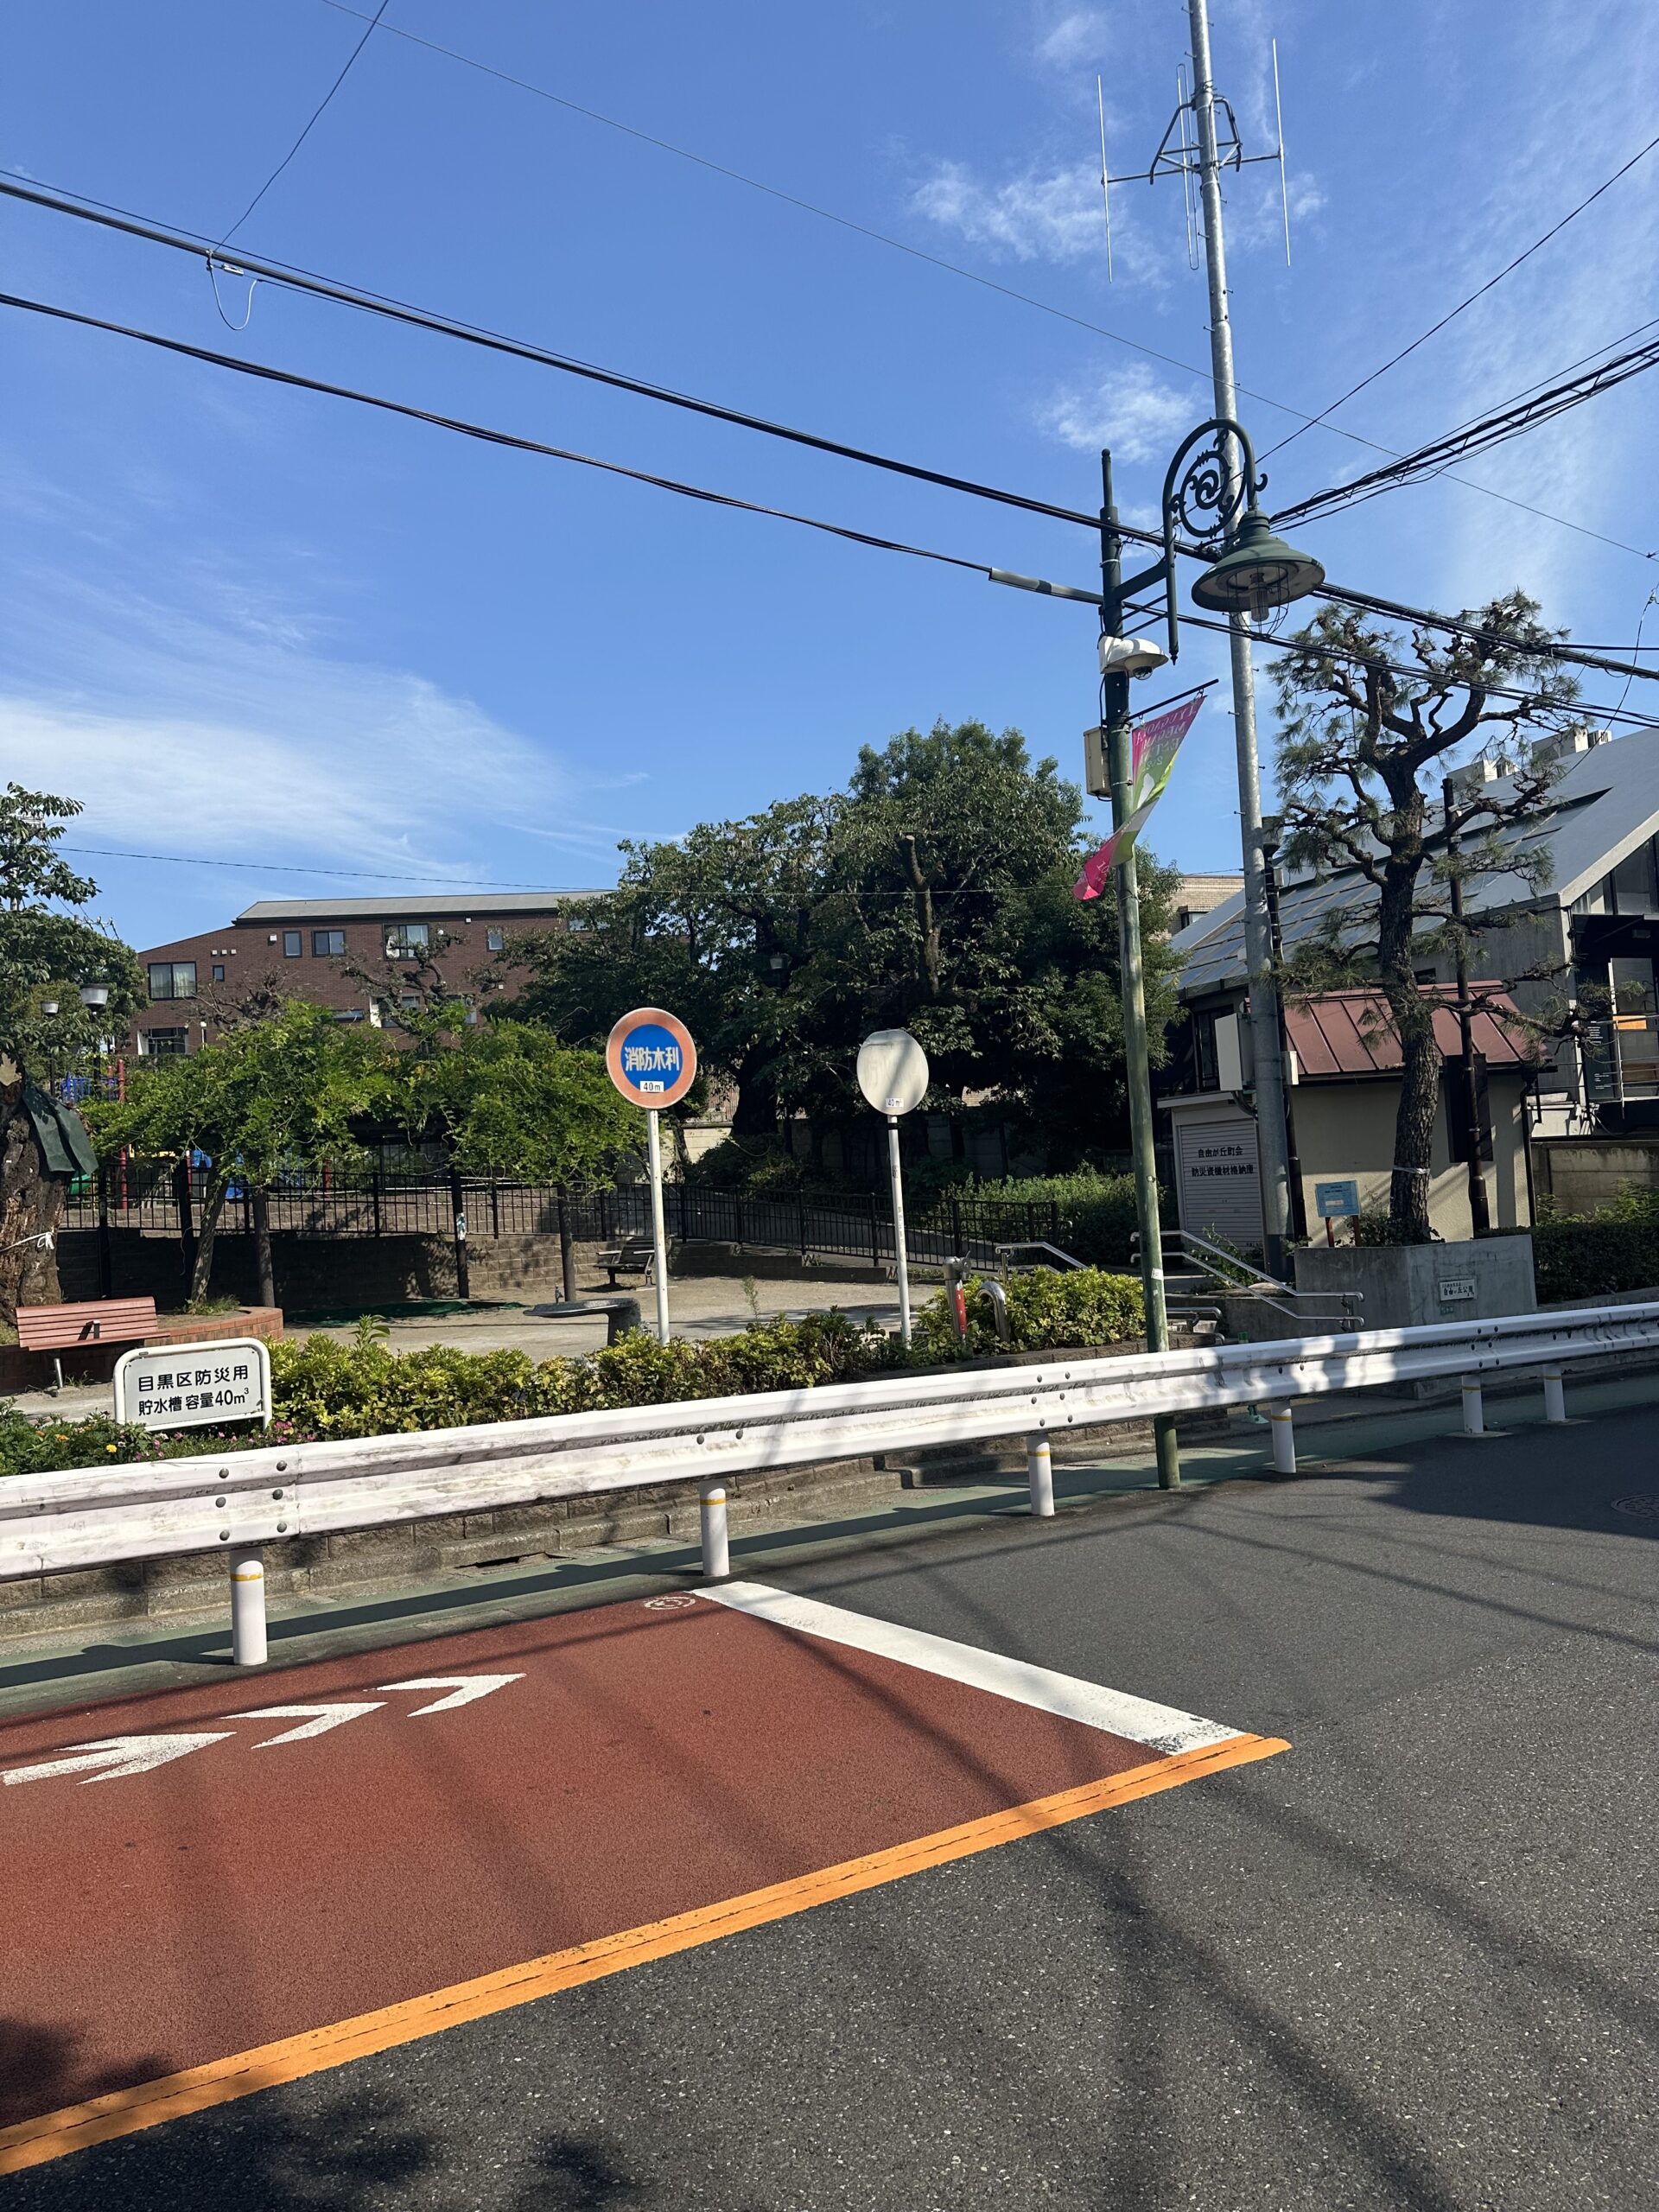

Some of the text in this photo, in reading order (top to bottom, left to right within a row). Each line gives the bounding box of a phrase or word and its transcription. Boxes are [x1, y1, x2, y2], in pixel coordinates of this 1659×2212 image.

[1198, 1145, 1243, 1158] 自由が丘町会
[138, 1364, 249, 1392] 目黒区防災用
